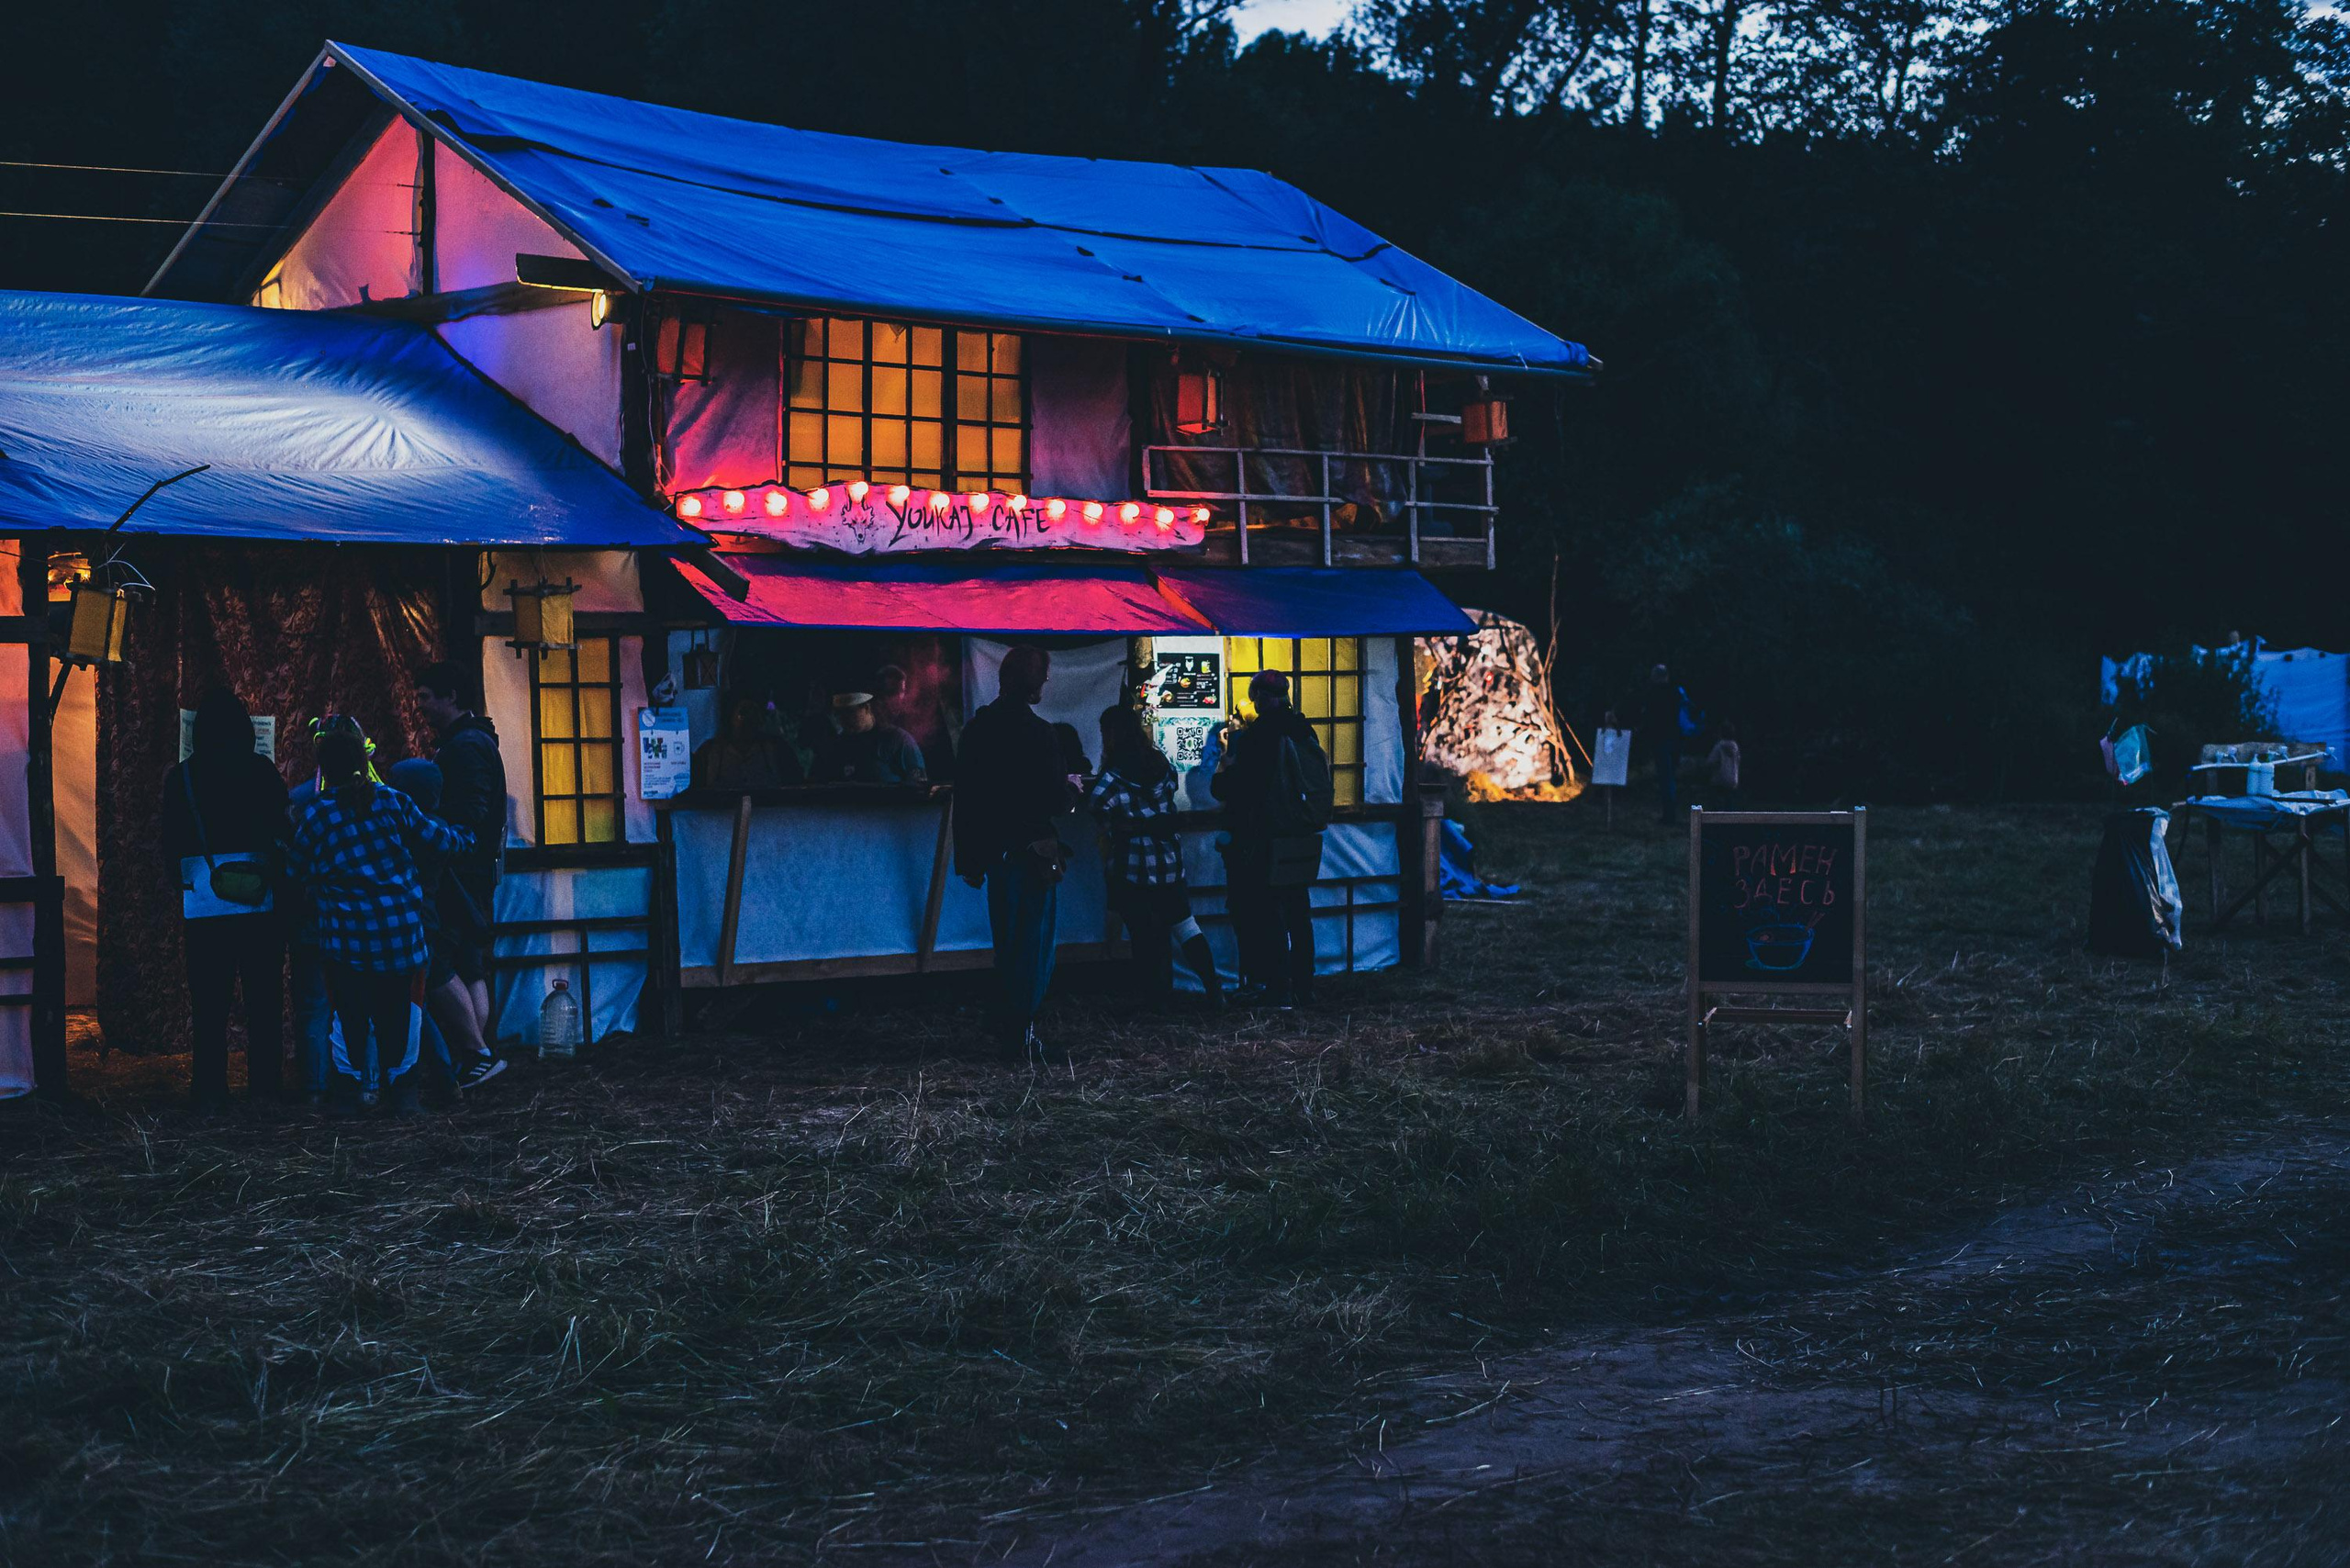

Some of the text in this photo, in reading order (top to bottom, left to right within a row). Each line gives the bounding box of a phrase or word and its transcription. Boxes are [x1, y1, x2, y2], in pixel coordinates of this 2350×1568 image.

[991, 504, 1051, 543] CAFE
[1732, 843, 1839, 877] РАМЕН
[1732, 878, 1836, 909] ЗДЕСЬ
